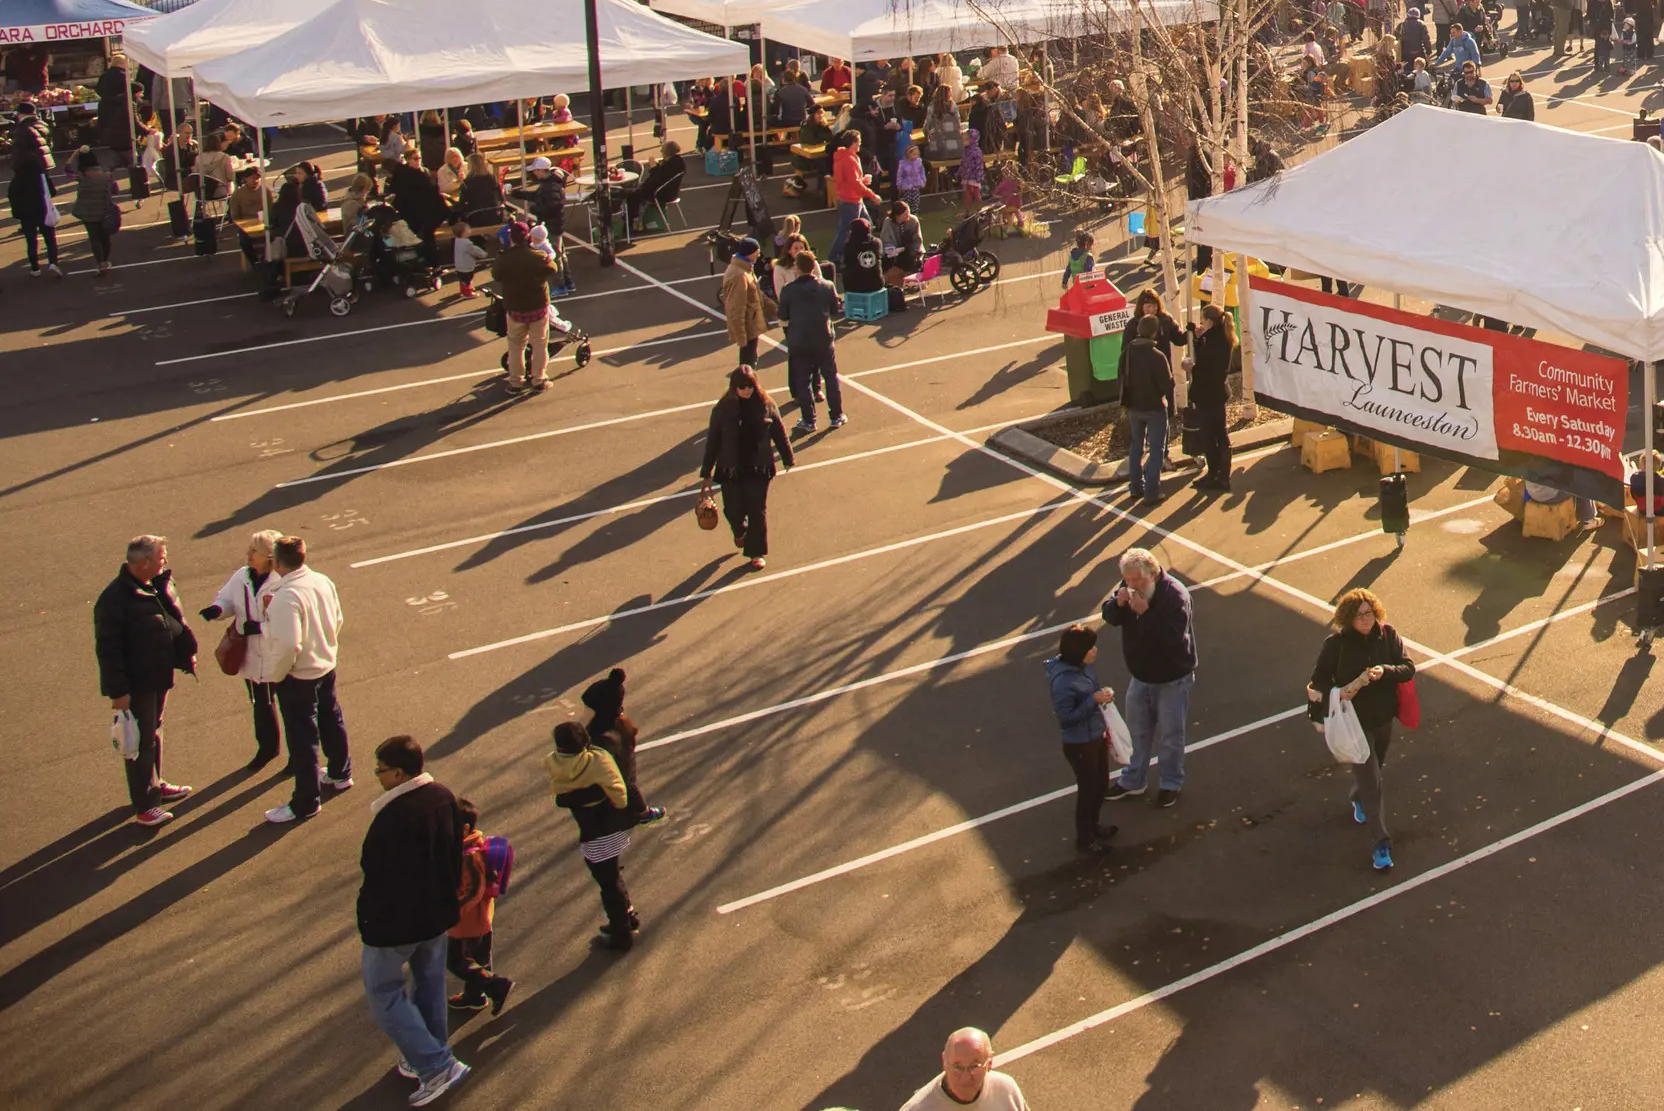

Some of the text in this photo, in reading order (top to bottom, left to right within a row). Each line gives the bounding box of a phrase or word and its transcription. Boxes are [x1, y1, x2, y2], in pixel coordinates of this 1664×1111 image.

[1099, 310, 1130, 323] GENERAL
[1105, 319, 1128, 331] WASTE
[1259, 305, 1478, 411] HARVEST
[1509, 373, 1616, 412] Farmers' Market
[1538, 360, 1614, 395] Community
[1343, 378, 1479, 441] Launceston
[1526, 406, 1615, 442] Every Saturday
[1513, 423, 1557, 445] 8.30am
